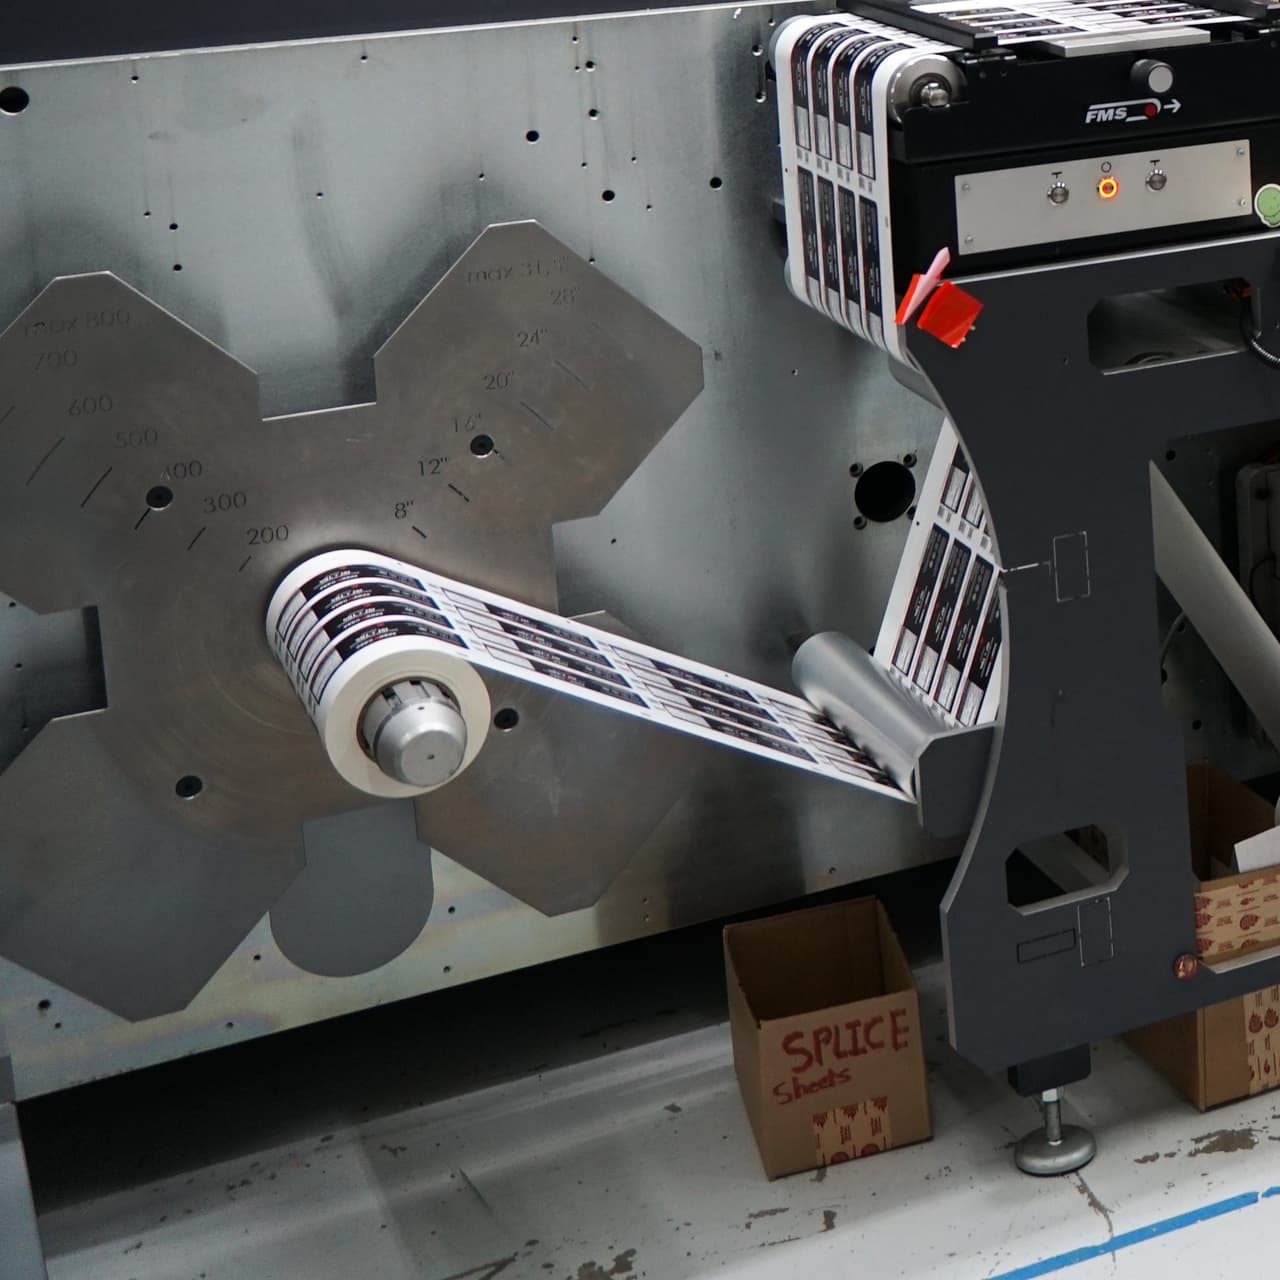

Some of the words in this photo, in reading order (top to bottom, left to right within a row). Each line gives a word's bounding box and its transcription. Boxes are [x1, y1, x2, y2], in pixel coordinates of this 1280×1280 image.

[1085, 107, 1127, 123] FMS
[35, 349, 78, 370] 700
[68, 396, 113, 416] 600
[113, 429, 158, 449] 500
[203, 491, 247, 514] 300
[246, 524, 289, 546] 200
[781, 1007, 911, 1074] SPLICE
